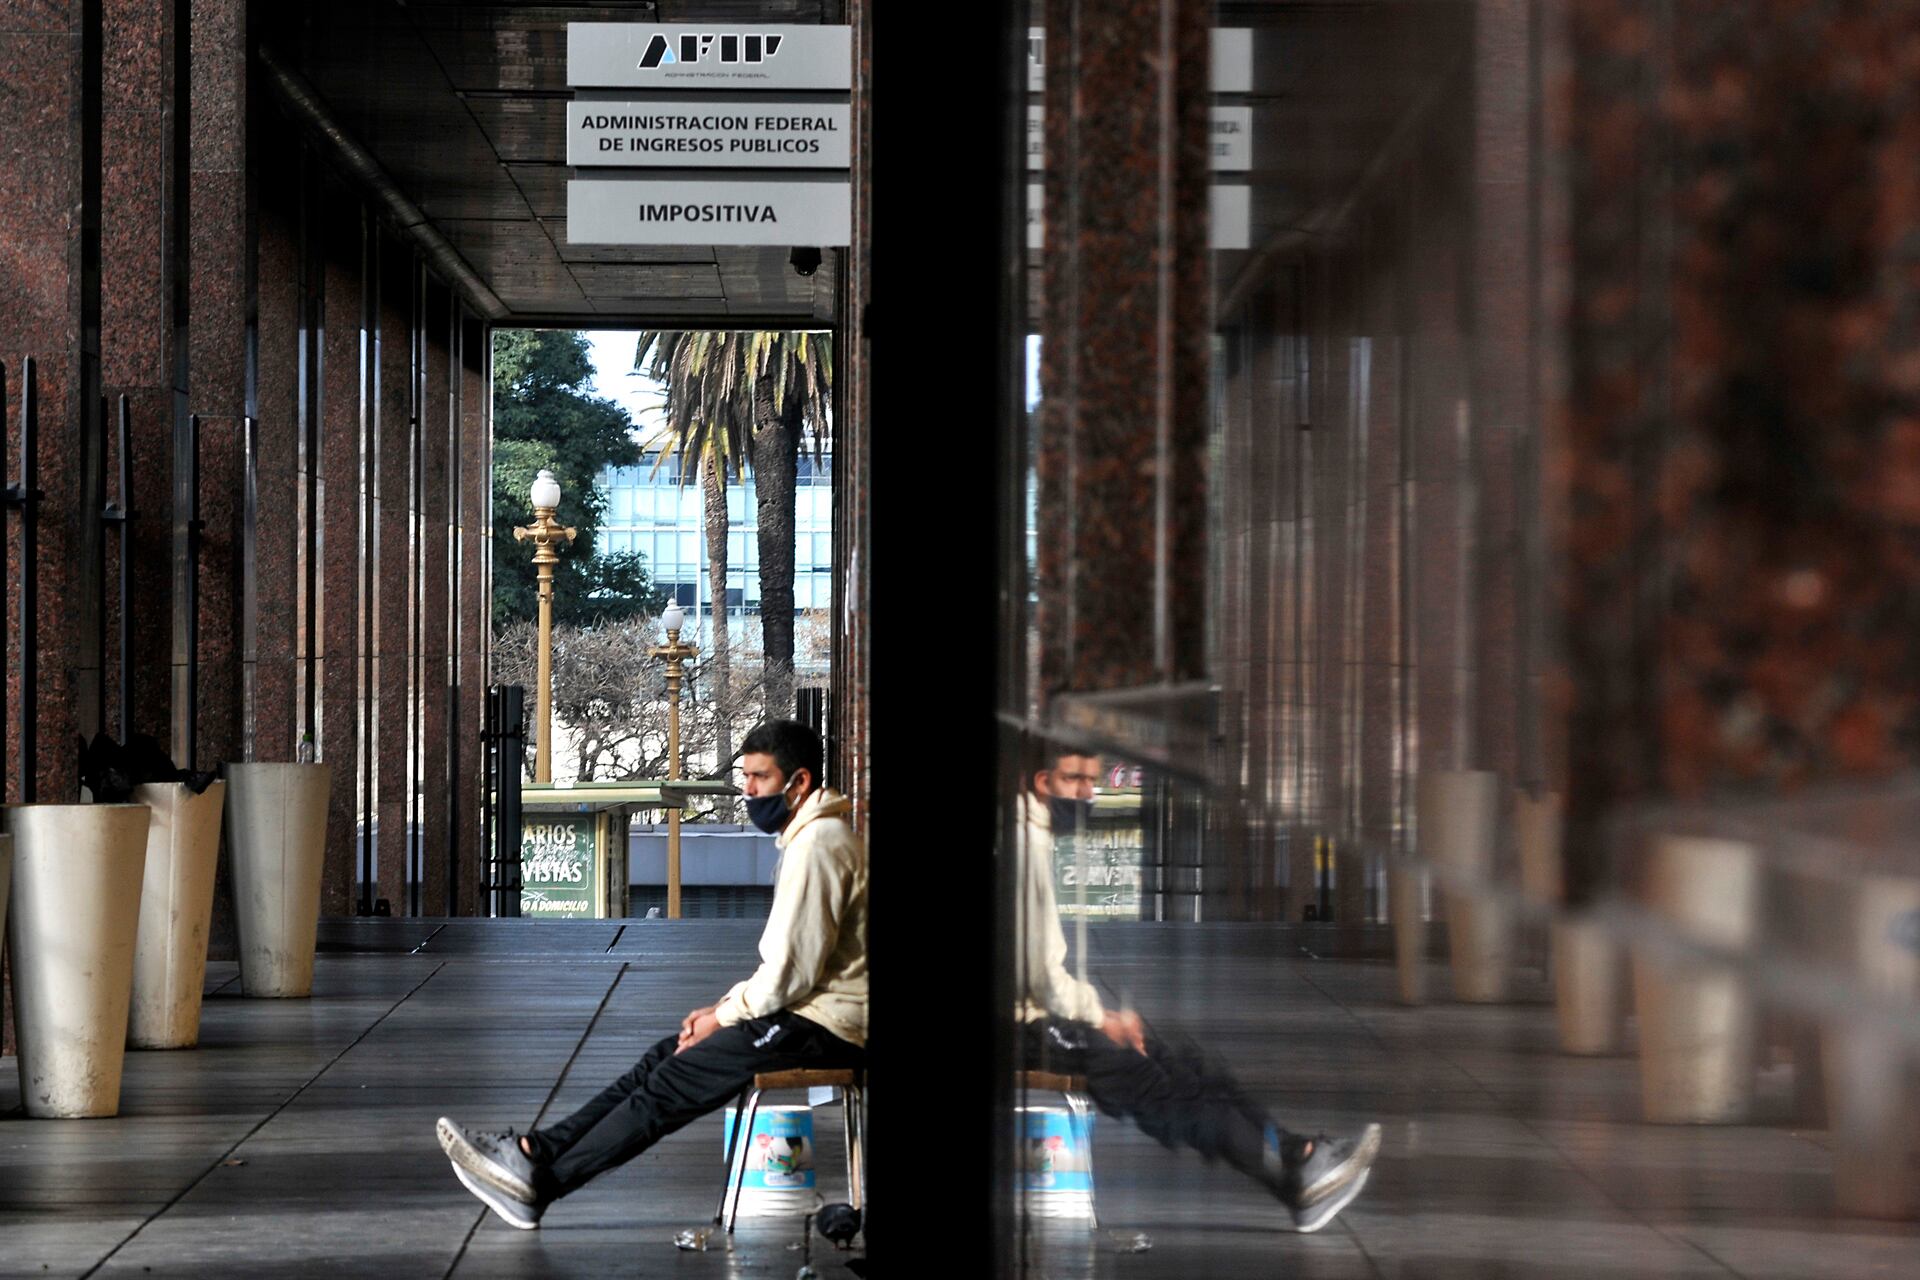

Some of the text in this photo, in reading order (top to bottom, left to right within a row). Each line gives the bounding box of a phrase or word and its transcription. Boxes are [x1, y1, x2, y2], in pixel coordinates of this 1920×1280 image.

[637, 33, 784, 69] AFIP
[581, 115, 838, 132] ADMINISTRACION FEDERAL
[599, 138, 820, 154] DE INGRESOS PUBLICOS
[639, 204, 777, 223] IMPOSITIVA
[521, 824, 576, 845] ARIOS
[520, 860, 583, 883] VISTAS
[539, 900, 589, 912] DOMICILIO
